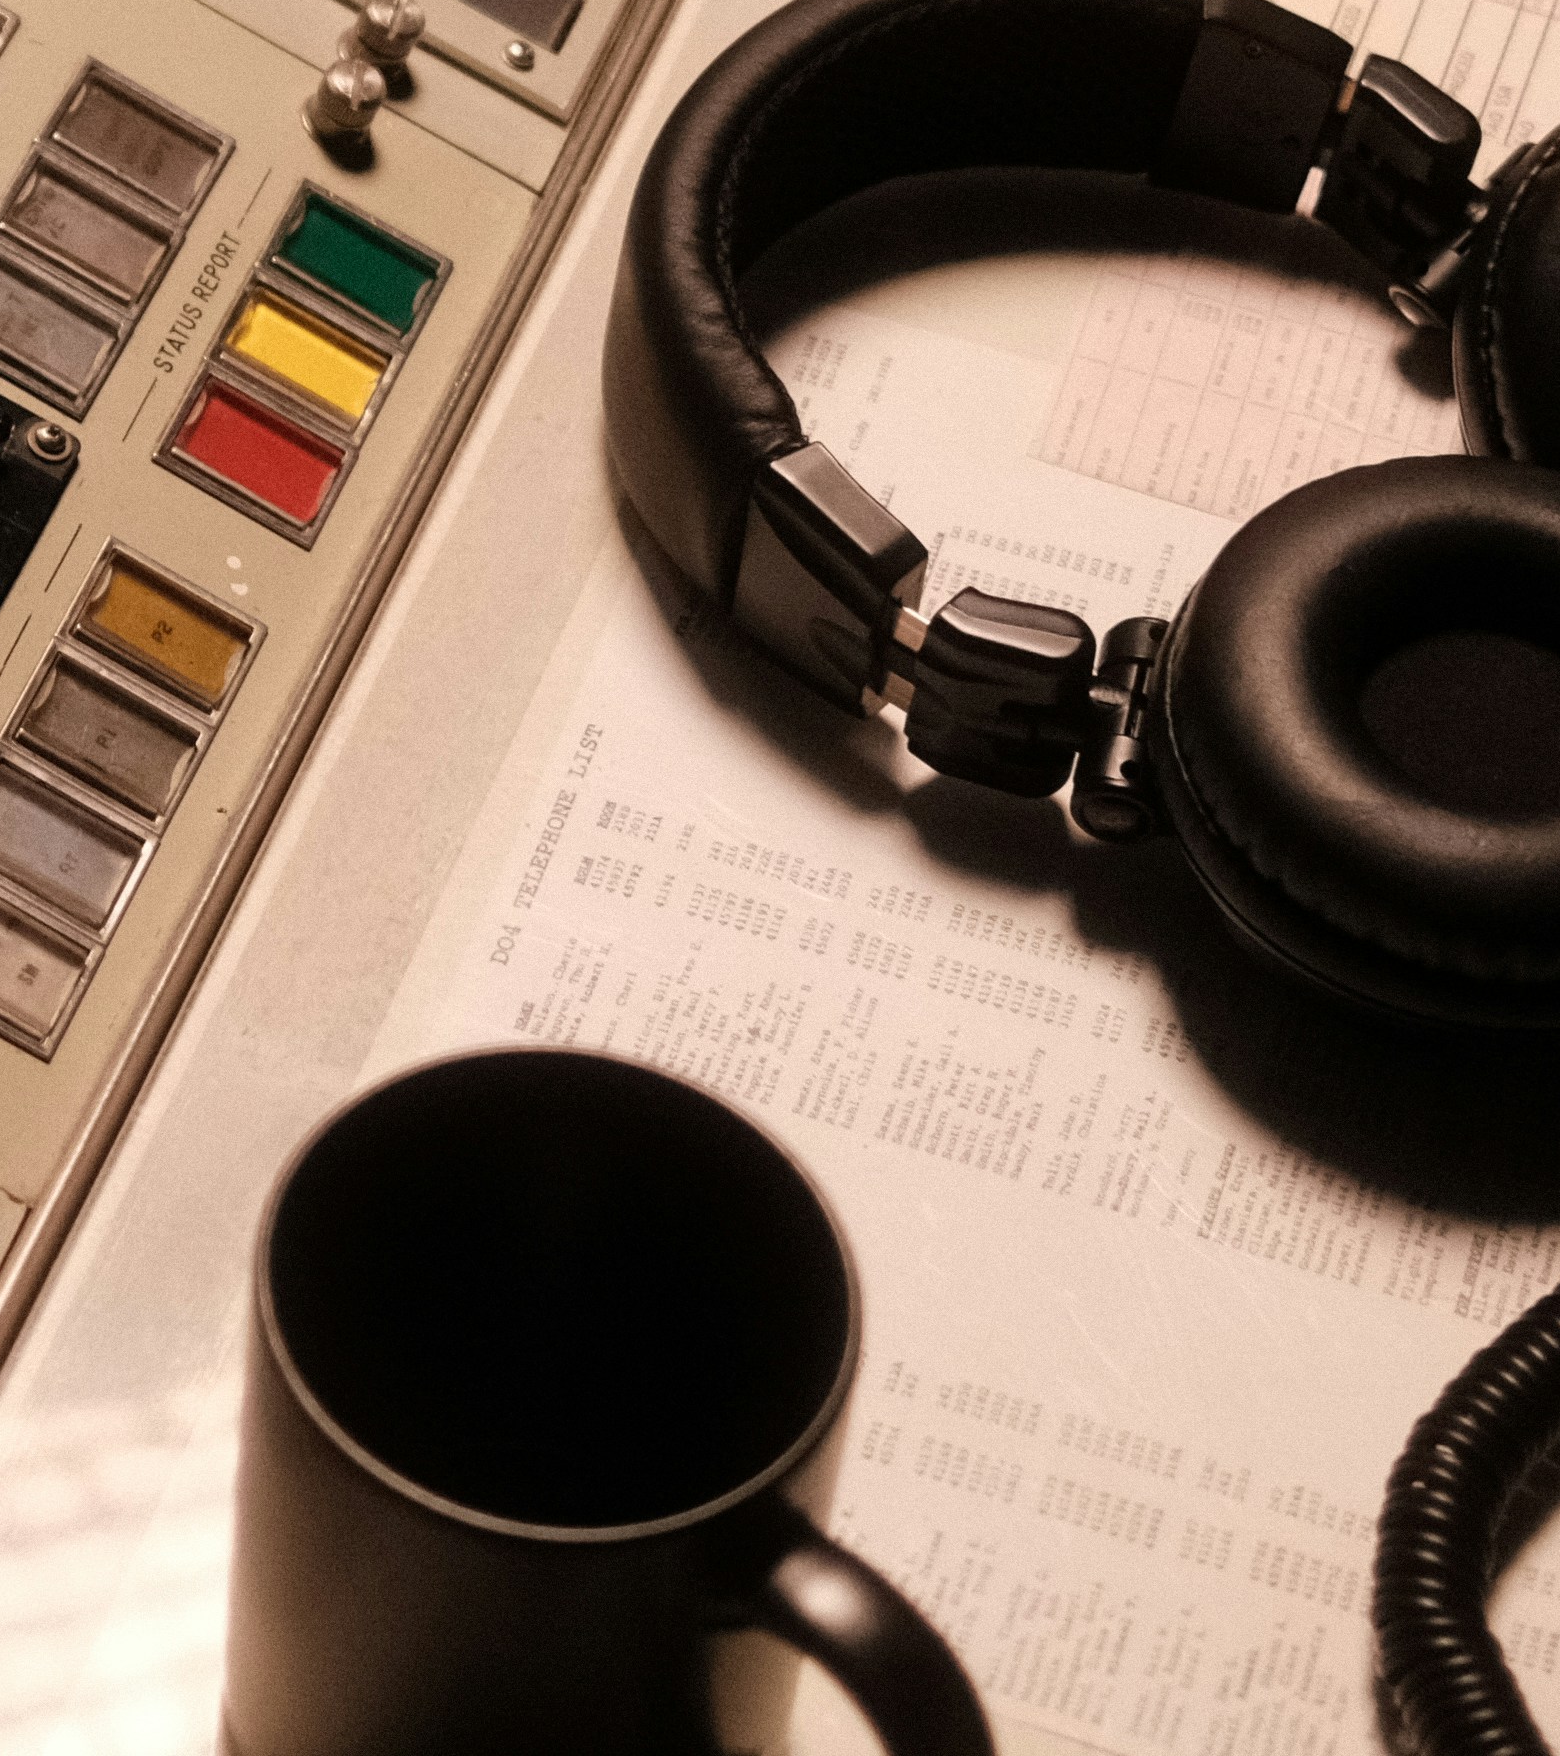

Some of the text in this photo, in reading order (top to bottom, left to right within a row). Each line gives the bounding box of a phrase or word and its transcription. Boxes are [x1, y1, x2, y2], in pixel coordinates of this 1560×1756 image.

[153, 230, 242, 375] STATUS REPORT
[149, 618, 174, 645] P2
[513, 788, 579, 912] TELEPHONE
[567, 722, 604, 781] LIST
[946, 1061, 965, 1097] Peter
